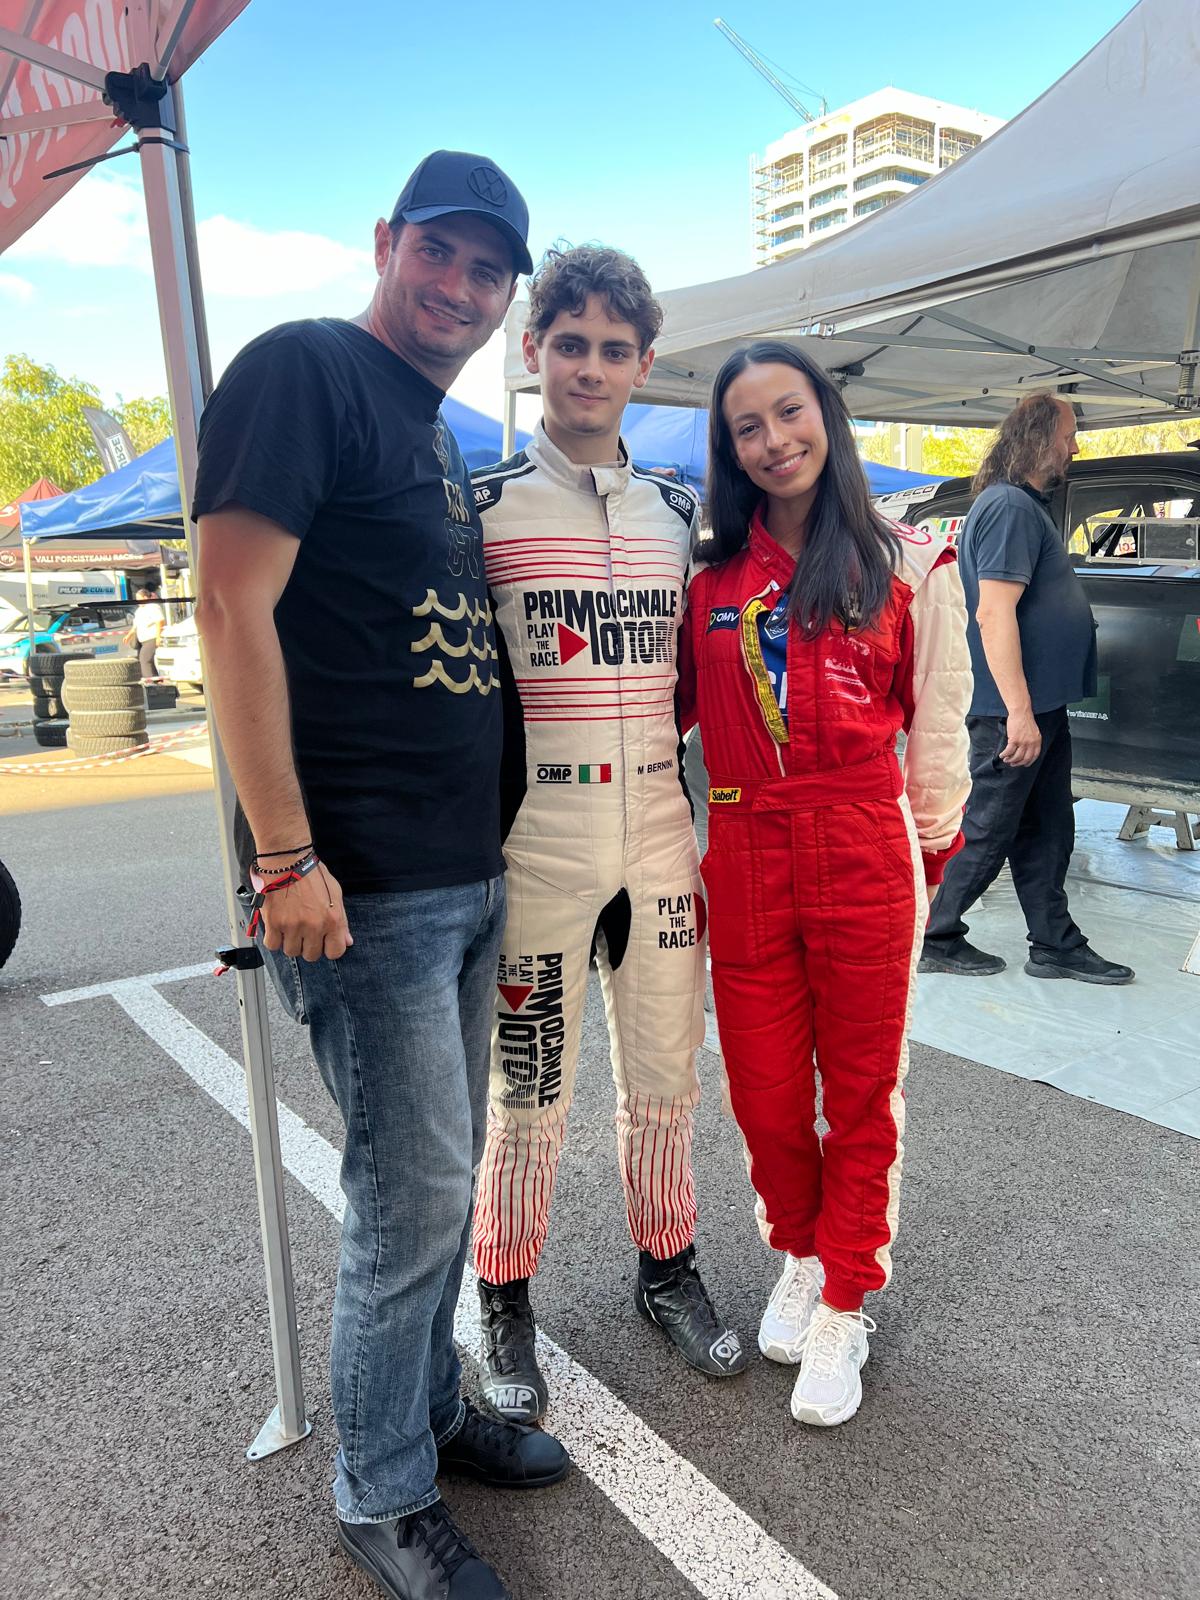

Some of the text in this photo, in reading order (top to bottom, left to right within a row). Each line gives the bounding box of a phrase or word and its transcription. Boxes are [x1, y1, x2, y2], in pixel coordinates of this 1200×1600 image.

[474, 489, 491, 502] MP
[669, 493, 691, 511] OMP
[60, 586, 82, 594] PILOT
[716, 612, 740, 622] OMV
[527, 622, 555, 640] PLAY
[536, 640, 550, 651] THE
[530, 651, 559, 667] RACE
[537, 766, 571, 781] OMP
[637, 759, 673, 775] M BERNINI
[658, 893, 691, 915] PLAY
[669, 916, 686, 928] THE
[659, 928, 695, 948] RACE
[508, 964, 517, 977] THE
[519, 955, 534, 983] PLAY
[716, 1331, 741, 1359] OM
